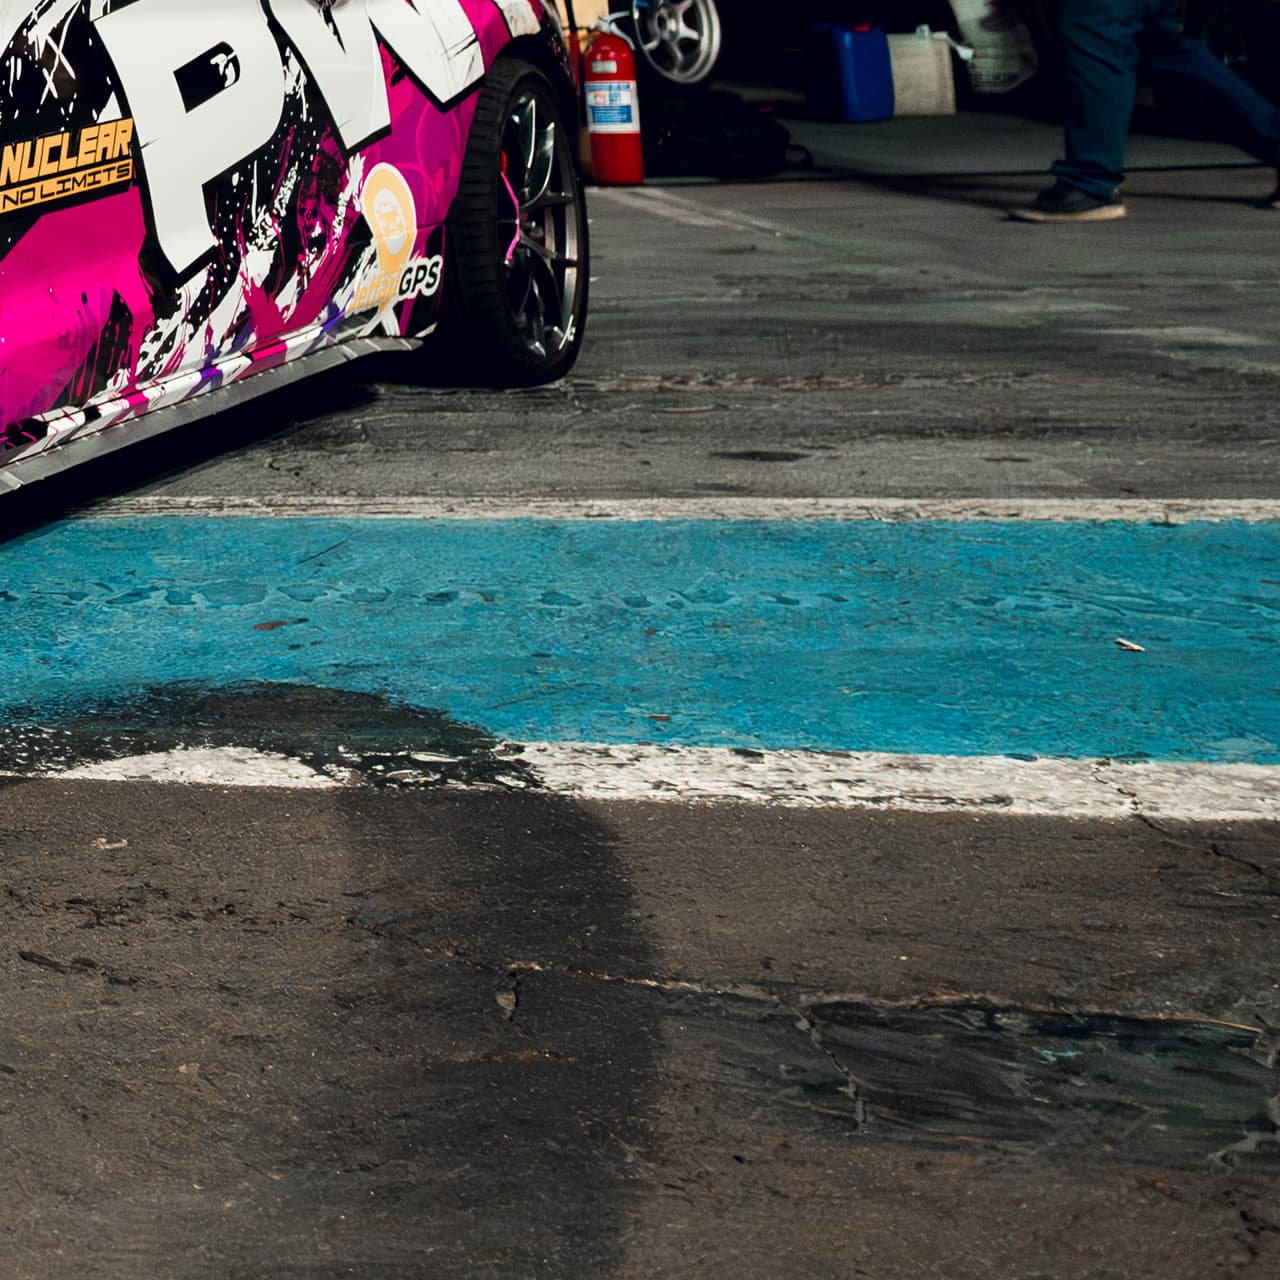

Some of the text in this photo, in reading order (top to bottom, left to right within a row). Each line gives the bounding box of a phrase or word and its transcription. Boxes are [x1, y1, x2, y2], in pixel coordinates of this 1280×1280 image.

[2, 162, 131, 210] NO LIMITS
[398, 260, 441, 296] GPS
